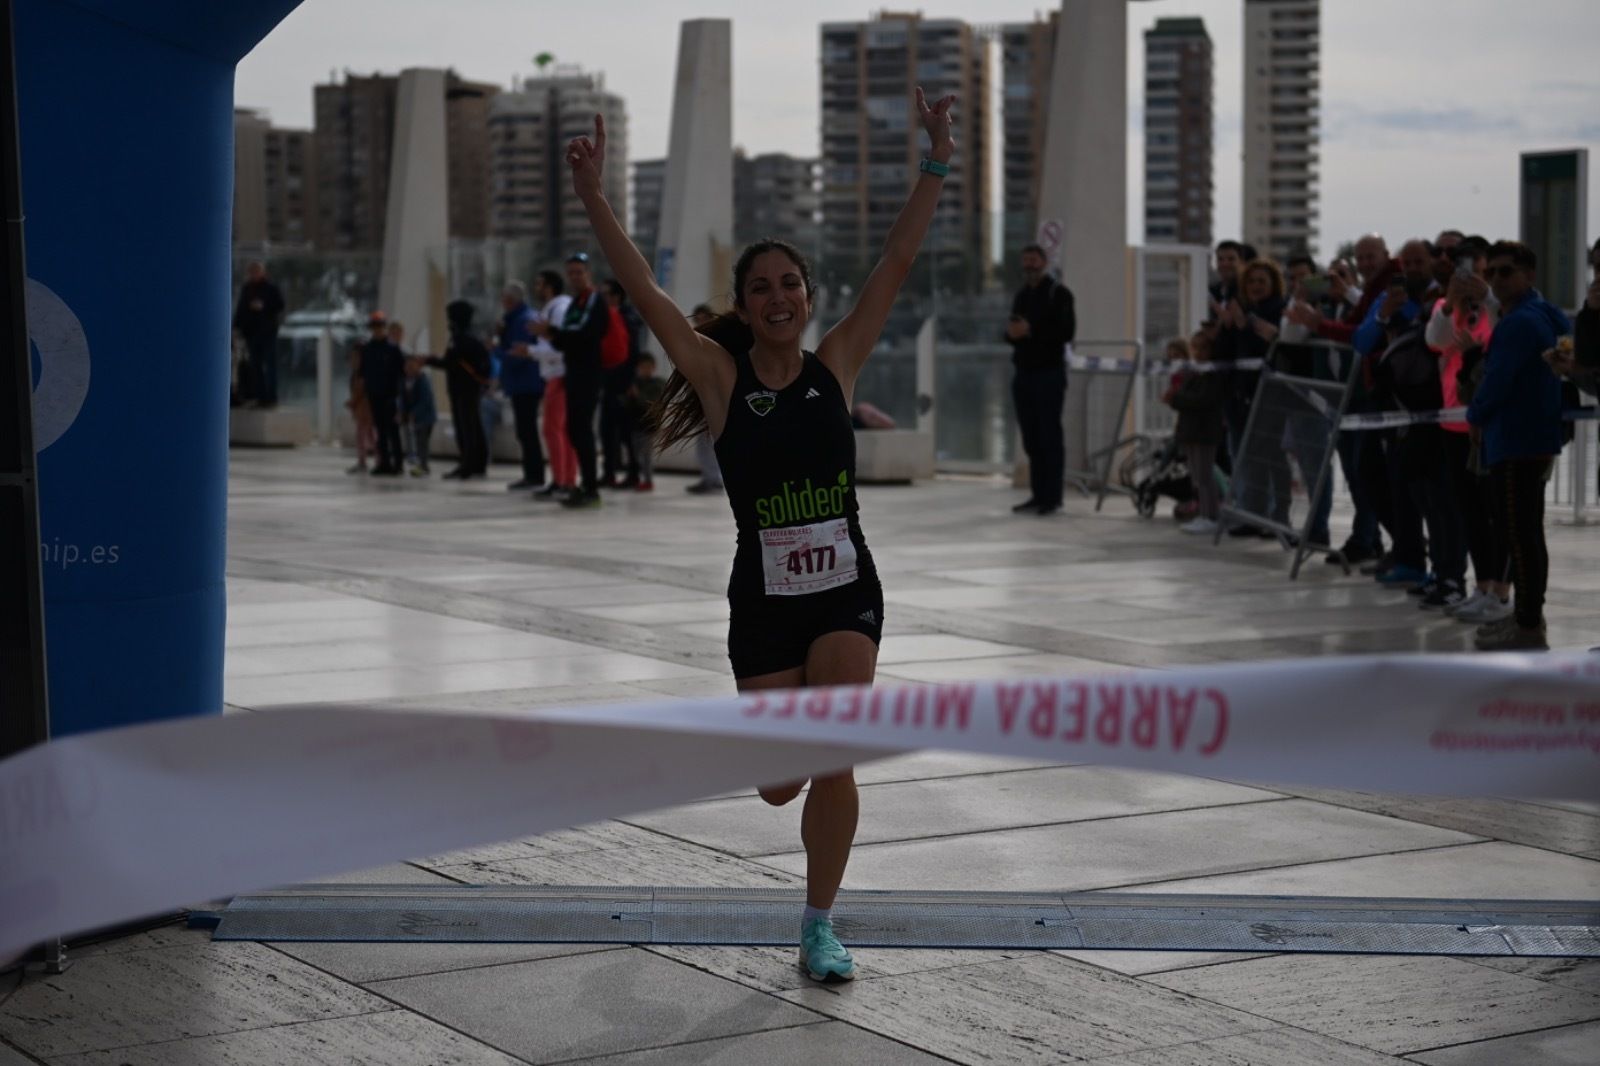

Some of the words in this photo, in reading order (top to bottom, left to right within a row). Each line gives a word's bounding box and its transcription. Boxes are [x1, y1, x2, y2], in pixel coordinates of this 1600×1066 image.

[756, 476, 844, 528] solideo
[787, 545, 837, 575] 4177
[995, 682, 1230, 758] CARRERA
